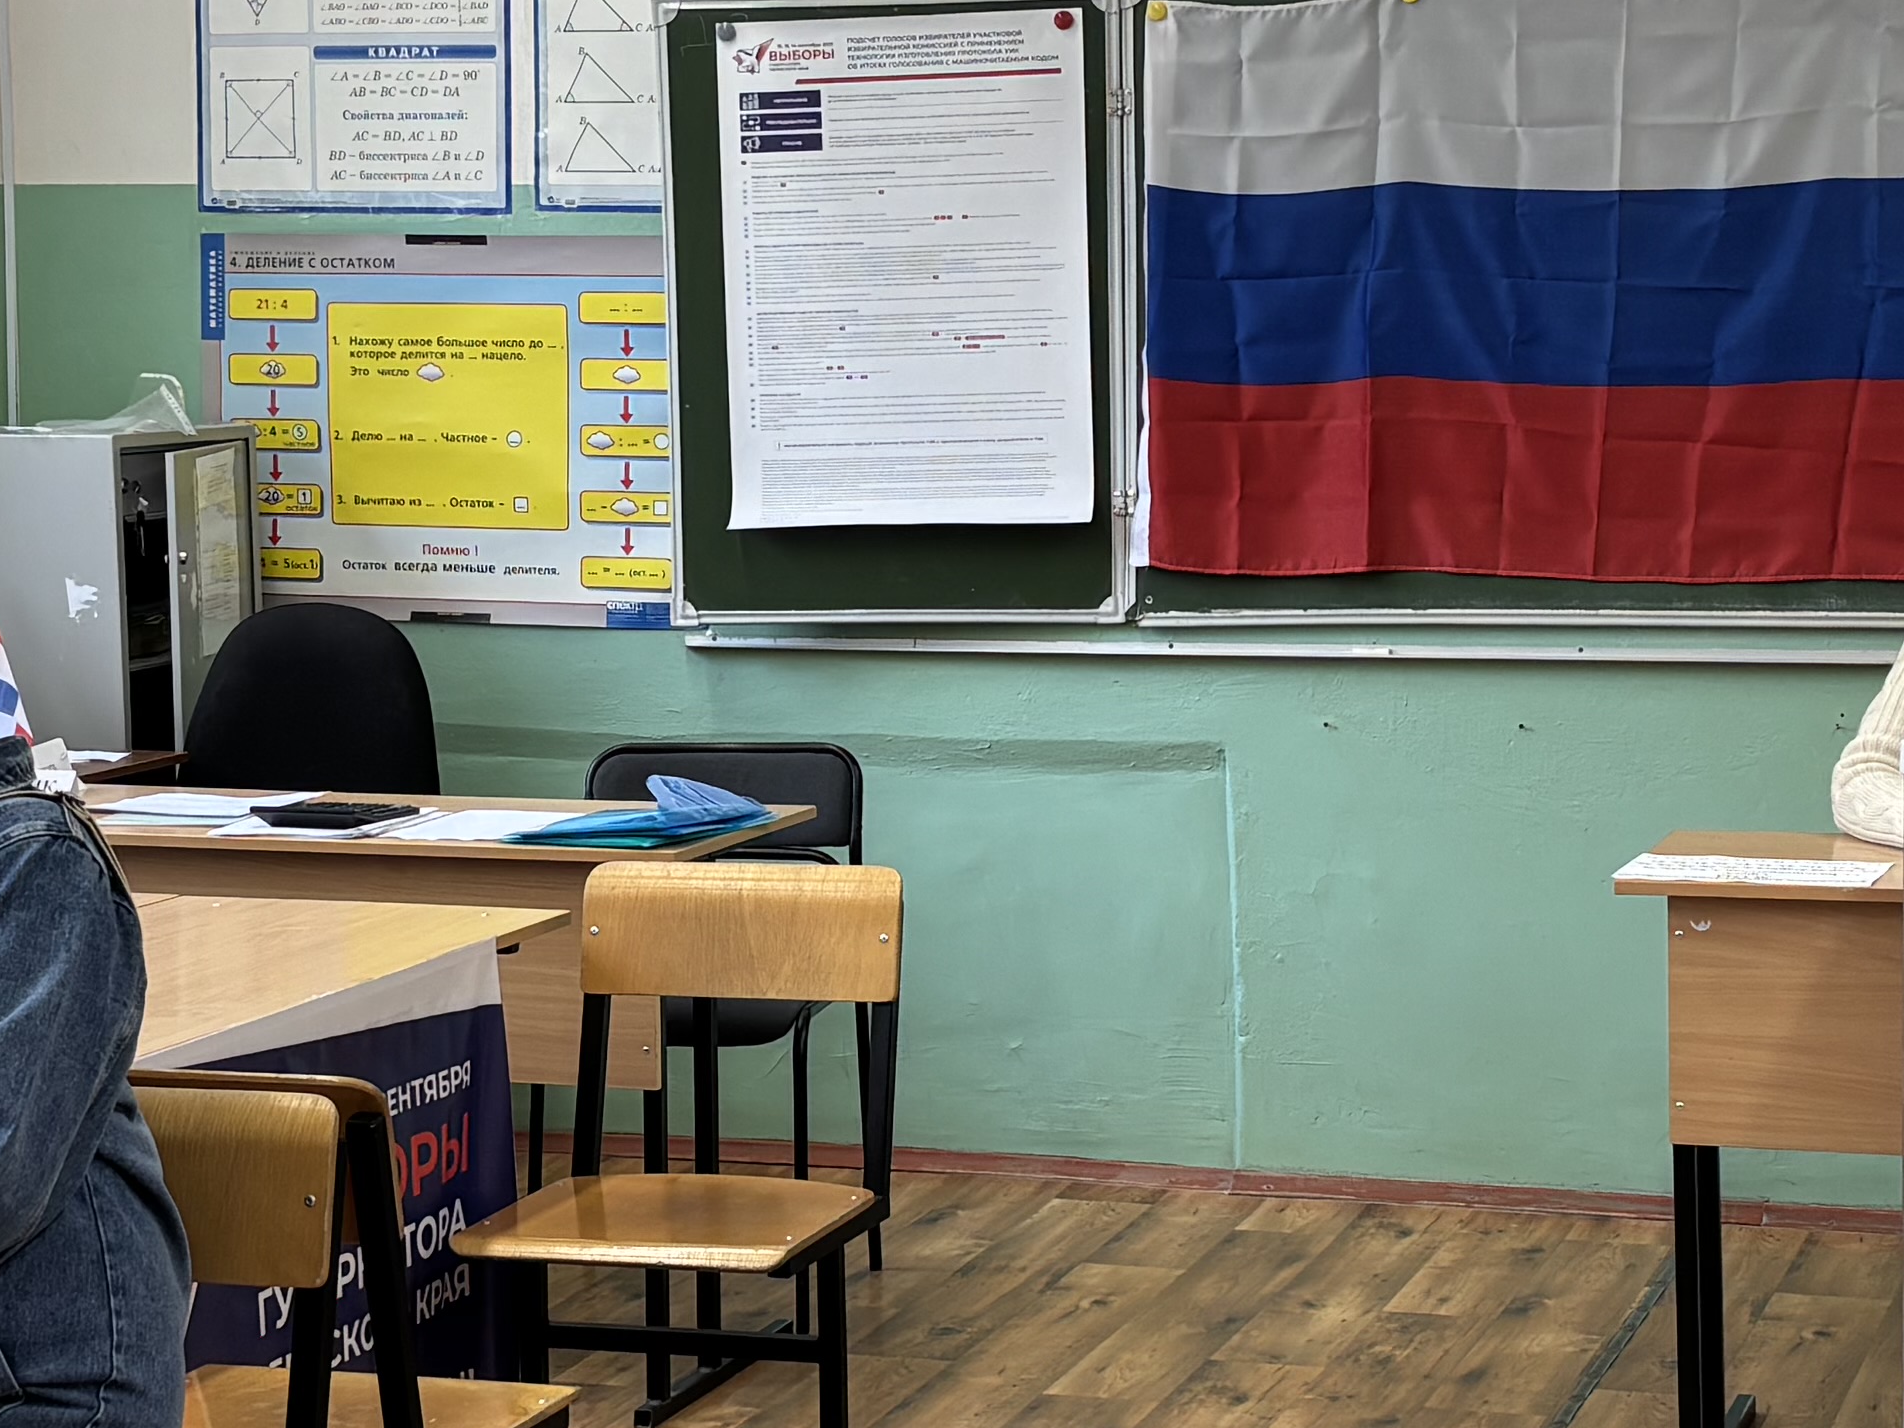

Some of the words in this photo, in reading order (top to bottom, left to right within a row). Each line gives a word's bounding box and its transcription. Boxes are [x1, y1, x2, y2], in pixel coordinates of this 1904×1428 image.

[368, 47, 439, 59] КВАДРАТ
[769, 49, 835, 61] ВЫБОРЫ
[230, 258, 241, 268] 4.
[246, 257, 304, 269] ДЕЛЕНИЕ
[308, 258, 316, 268] С
[321, 258, 395, 269] ОСТАТКОМ
[256, 299, 269, 309] 21
[281, 299, 288, 309] 4
[349, 337, 393, 349] Нахожу
[437, 336, 488, 348] большое
[529, 340, 543, 349] до
[349, 350, 396, 360] которое
[400, 351, 446, 360] делится
[482, 352, 526, 361] нацело.
[266, 364, 279, 375] 20
[350, 367, 369, 376] Это
[377, 368, 409, 376] число
[334, 431, 343, 440] 2.
[351, 432, 383, 442] Делю
[400, 433, 413, 441] на
[441, 433, 488, 442] Частное
[336, 495, 346, 504] 3.
[354, 496, 405, 507] Вычитаю
[409, 498, 422, 507] из
[450, 498, 494, 508] Остаток
[423, 544, 470, 556] Помню
[342, 560, 387, 571] Остаток
[395, 562, 437, 573] всегда
[442, 563, 496, 574] меньше
[504, 566, 560, 576] делителя.
[388, 1060, 471, 1117] ЕНТЯБРЯ
[416, 1263, 470, 1324] КРАЯ
